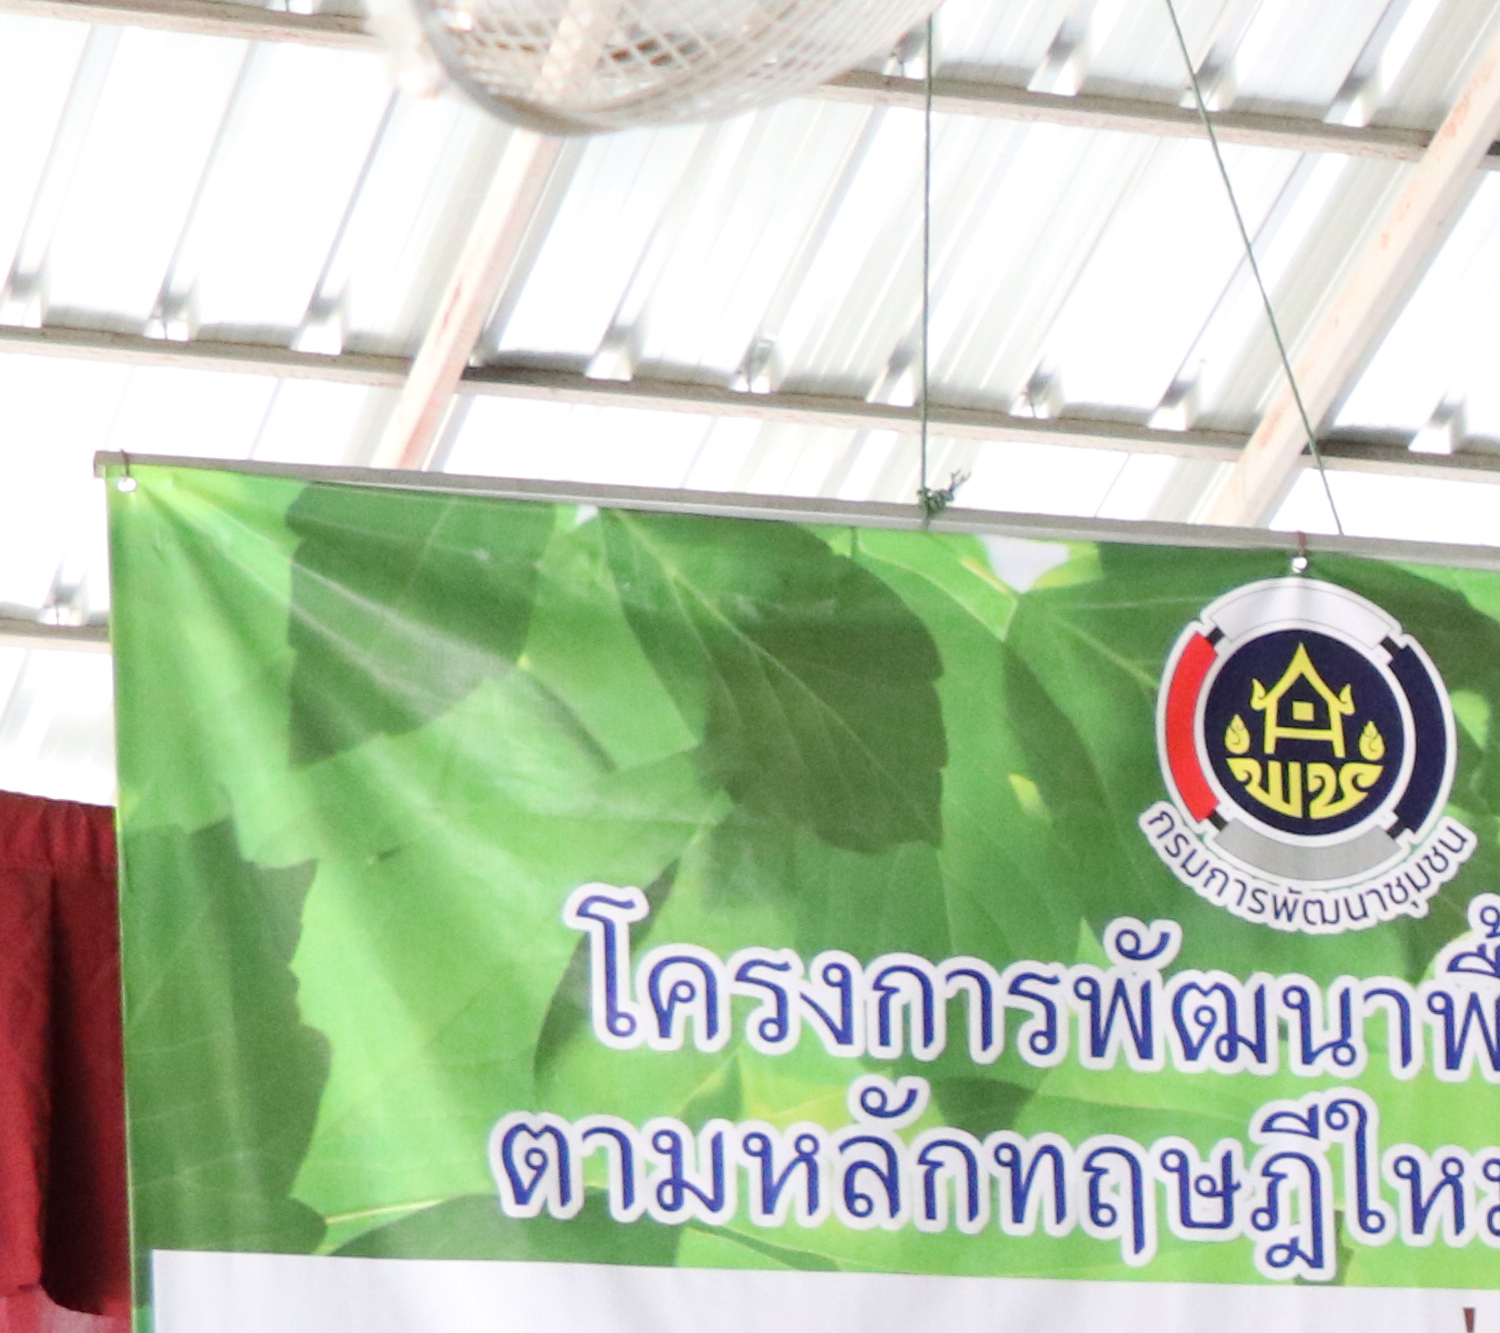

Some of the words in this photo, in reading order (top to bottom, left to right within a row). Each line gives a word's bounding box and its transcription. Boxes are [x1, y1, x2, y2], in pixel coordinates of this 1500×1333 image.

[1146, 808, 1469, 926] กรมการพัฒนาชุมชน
